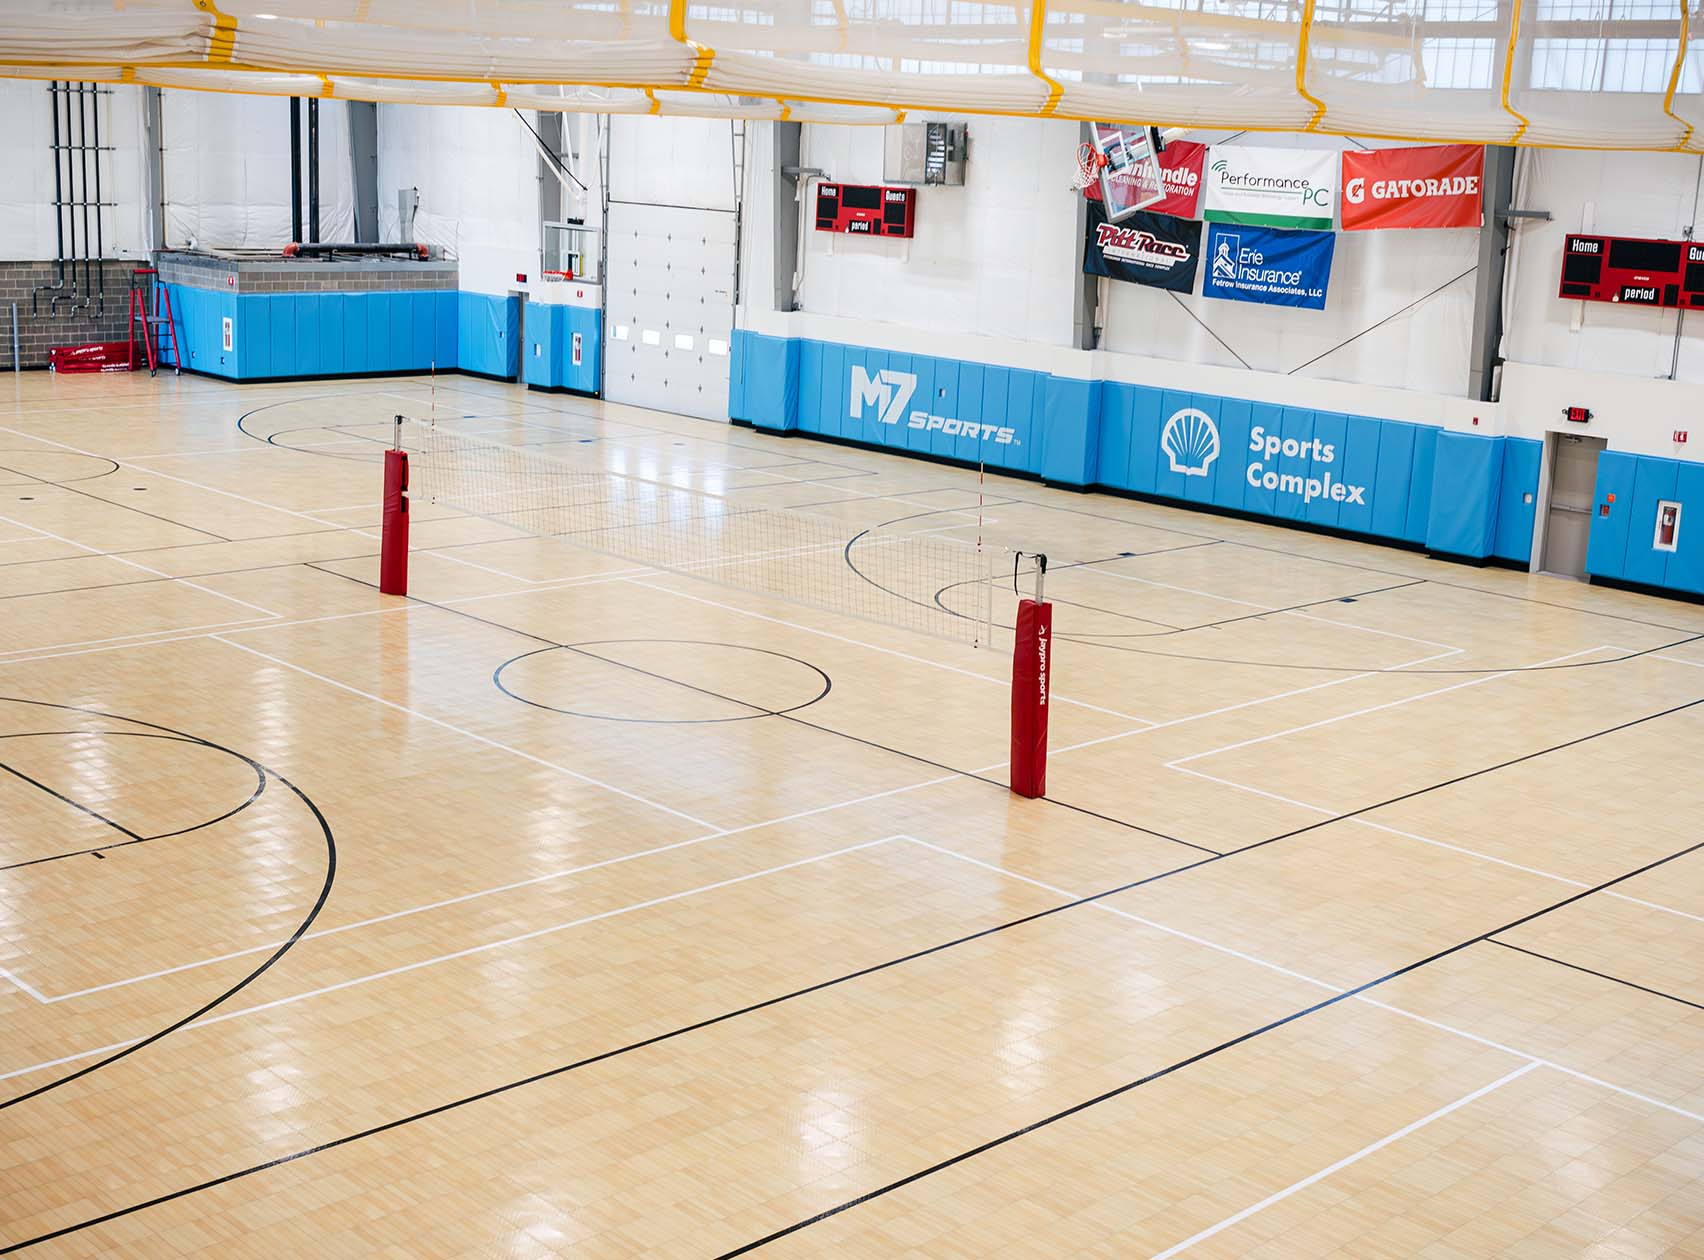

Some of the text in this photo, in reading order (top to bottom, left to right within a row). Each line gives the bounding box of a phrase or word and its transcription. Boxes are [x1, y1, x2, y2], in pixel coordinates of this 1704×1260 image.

[1220, 171, 1310, 191] Performance
[1371, 176, 1479, 199] GATORADE
[821, 186, 837, 197] Home
[885, 190, 906, 202] Guests
[1302, 188, 1330, 207] PC
[851, 221, 869, 231] period
[1096, 223, 1191, 261] Pitt Race
[1572, 239, 1599, 253] Home
[1240, 248, 1263, 265] Erie
[1238, 264, 1300, 285] Insurance
[1212, 279, 1323, 297] Fetrow Insurance Associates, LLC
[1624, 288, 1655, 300] period
[850, 365, 917, 424] M7
[1570, 407, 1586, 420] EXIT
[907, 411, 1015, 444] SPORTS
[1249, 426, 1335, 463] Sports
[1246, 462, 1367, 505] Complex
[1038, 672, 1046, 705] sports
